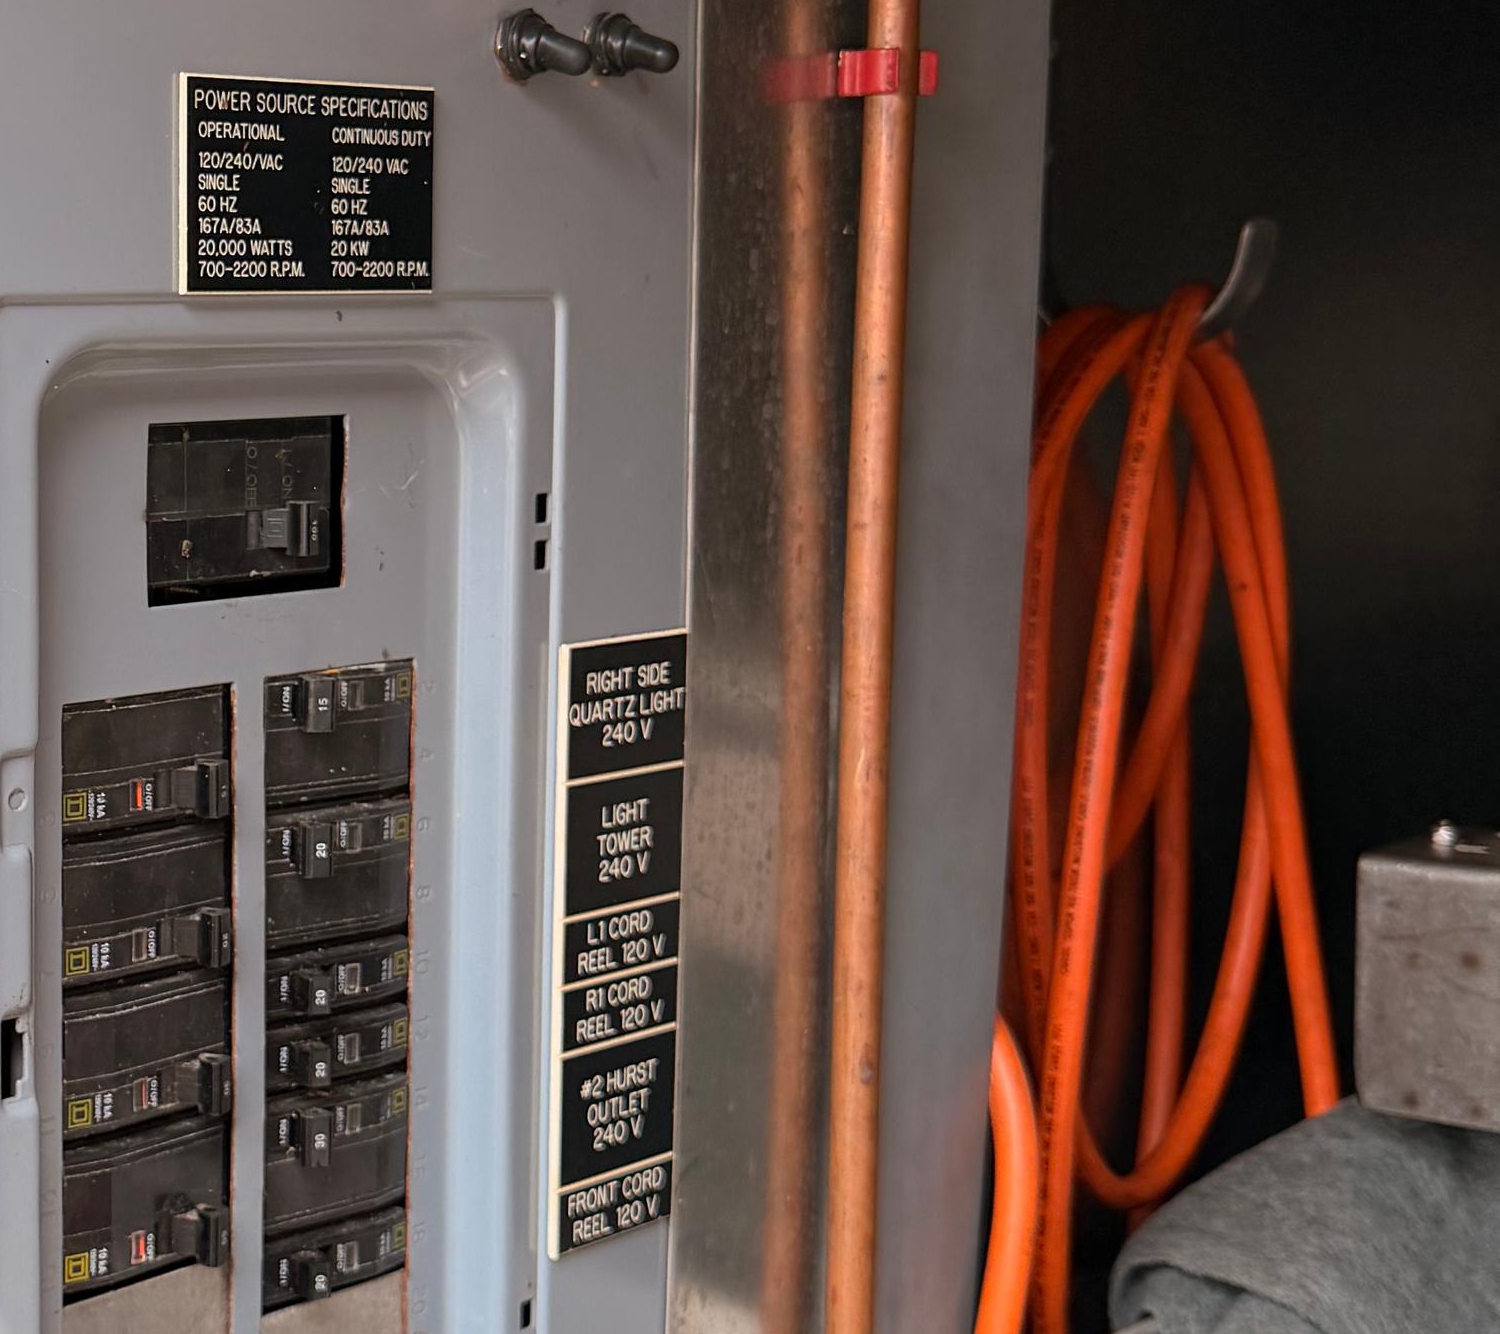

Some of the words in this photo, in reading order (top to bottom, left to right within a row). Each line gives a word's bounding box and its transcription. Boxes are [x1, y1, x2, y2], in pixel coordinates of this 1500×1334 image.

[194, 89, 251, 112] POWER
[256, 93, 316, 115] SOURCE
[321, 96, 427, 121] SPECIFICATIONS
[199, 121, 285, 141] OPERATIONAL
[332, 127, 399, 145] CONTINUOUS
[401, 130, 432, 147] DUTY
[199, 152, 283, 171] 120/240/VAC
[332, 157, 382, 173] 120/240
[386, 159, 409, 175] VAC
[199, 174, 240, 191] SINGLE
[331, 178, 371, 194] SINGLE
[199, 196, 216, 212] 60
[220, 197, 238, 213] HZ
[331, 199, 347, 215] 60
[351, 199, 368, 215] HZ
[199, 218, 261, 235] 167A/83A
[332, 220, 389, 236] 167A/83A
[198, 240, 246, 257] 20,000
[250, 240, 293, 257] WATTS
[331, 241, 346, 257] 20
[350, 241, 370, 256] KW
[199, 261, 266, 277] 700-2200
[271, 262, 305, 278] R.P.M.
[331, 261, 393, 277] 700-2200
[397, 261, 429, 277] R.P.M.
[586, 667, 633, 695] RIGHT
[638, 661, 671, 688] SIDE
[569, 695, 636, 727] QUARTZ
[640, 686, 686, 715] LIGHT
[602, 723, 636, 747] 240
[640, 718, 652, 741] V
[602, 797, 650, 829] LIGHT
[316, 842, 327, 859] 20
[597, 826, 653, 856] TOWER
[599, 858, 632, 883] 240
[636, 851, 650, 876] V
[587, 921, 606, 946] L1
[608, 909, 652, 940] CORD
[578, 948, 618, 976] REEL
[622, 937, 648, 964] 120
[652, 933, 667, 958] V
[315, 989, 326, 1006] 20
[608, 975, 650, 1005] CORD
[576, 1015, 618, 1044] REEL
[621, 1004, 648, 1030] 120
[651, 998, 665, 1023] V
[315, 1061, 326, 1078] 20
[580, 1075, 605, 1100] #2
[607, 1058, 660, 1092] HURST
[587, 1087, 651, 1128] OUTLET
[593, 1119, 625, 1151] 240
[629, 1115, 645, 1139] V
[568, 1180, 619, 1218] FRONT
[622, 1166, 667, 1196] CORD
[572, 1212, 611, 1245] REEL
[616, 1201, 642, 1229] 120
[646, 1196, 659, 1219] V
